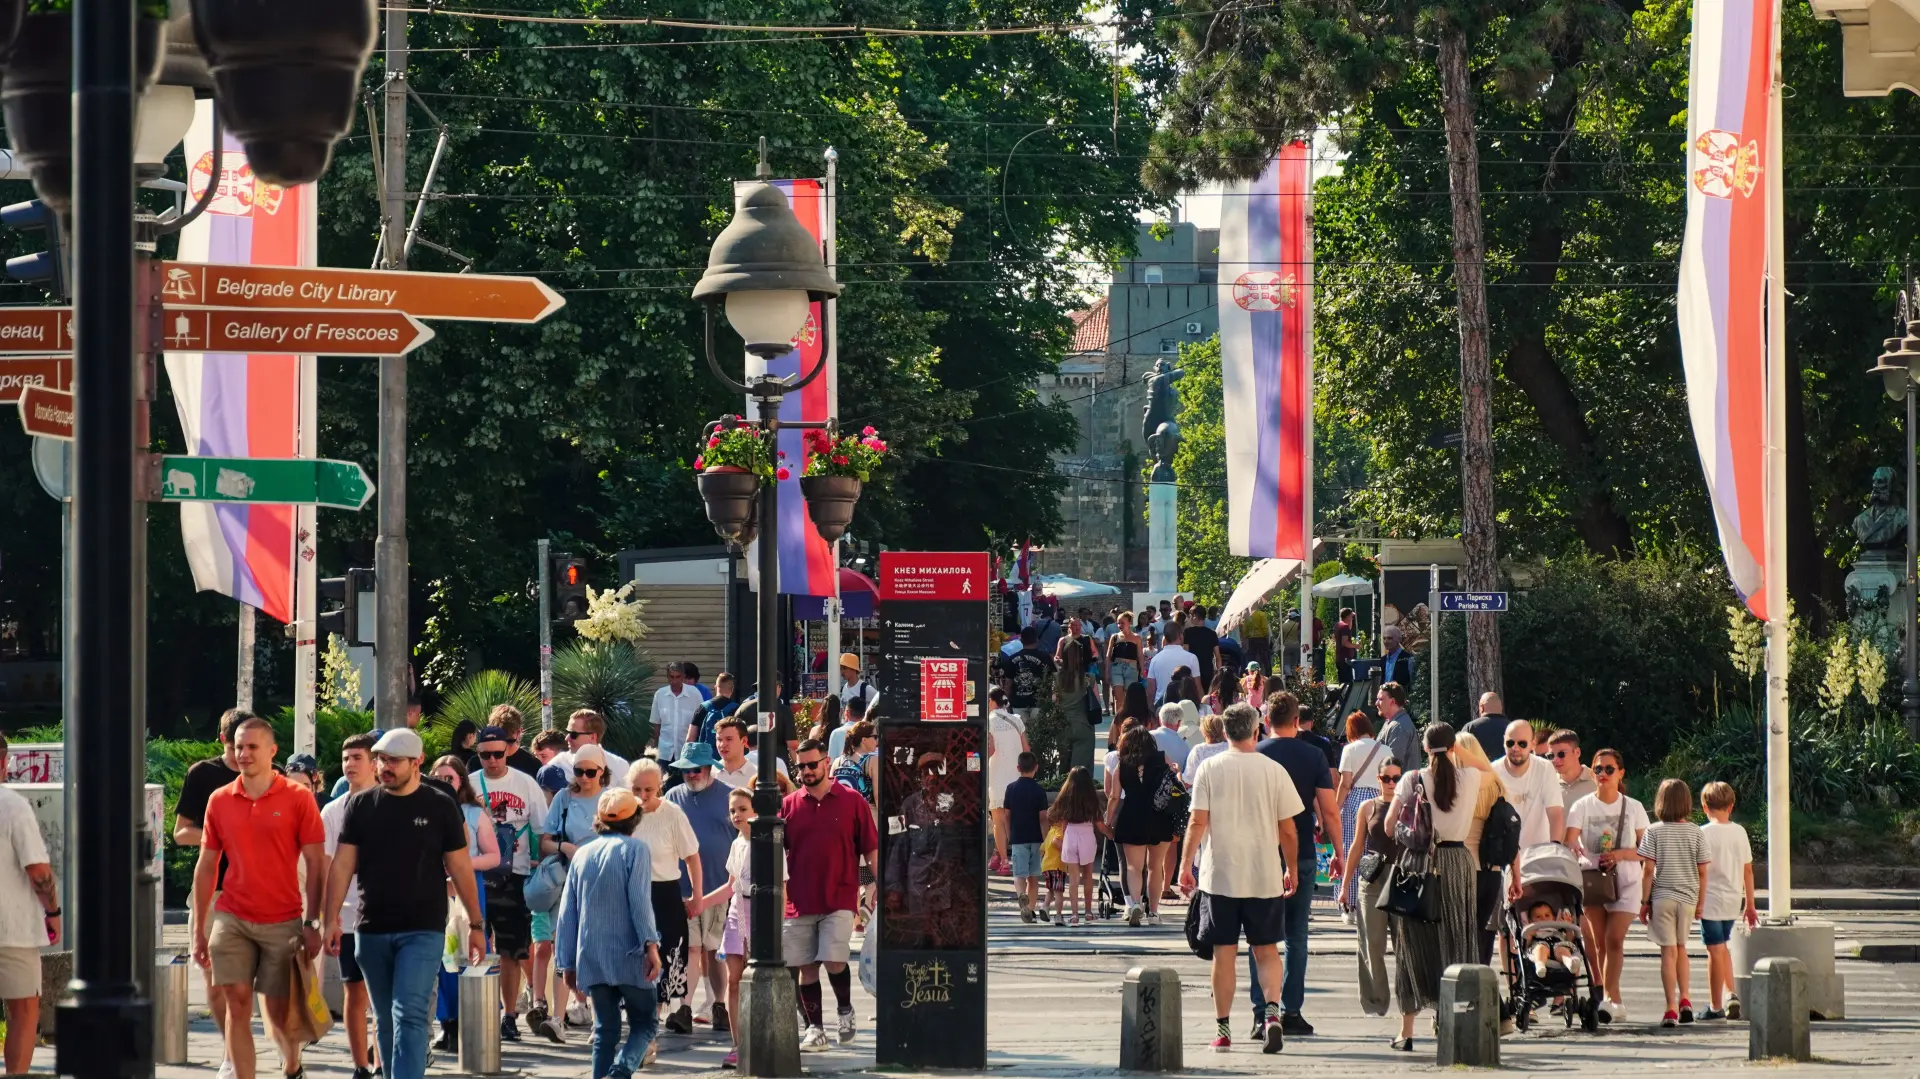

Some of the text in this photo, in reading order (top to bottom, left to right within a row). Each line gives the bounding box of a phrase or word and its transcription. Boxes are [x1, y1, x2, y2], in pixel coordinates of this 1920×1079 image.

[216, 278, 397, 306] Belgrade City Library
[0, 325, 44, 342] енац
[224, 320, 399, 344] Gallery of Frescoes
[0, 374, 45, 391] рква
[929, 662, 958, 673] VSB
[900, 979, 951, 1009] Jesus
